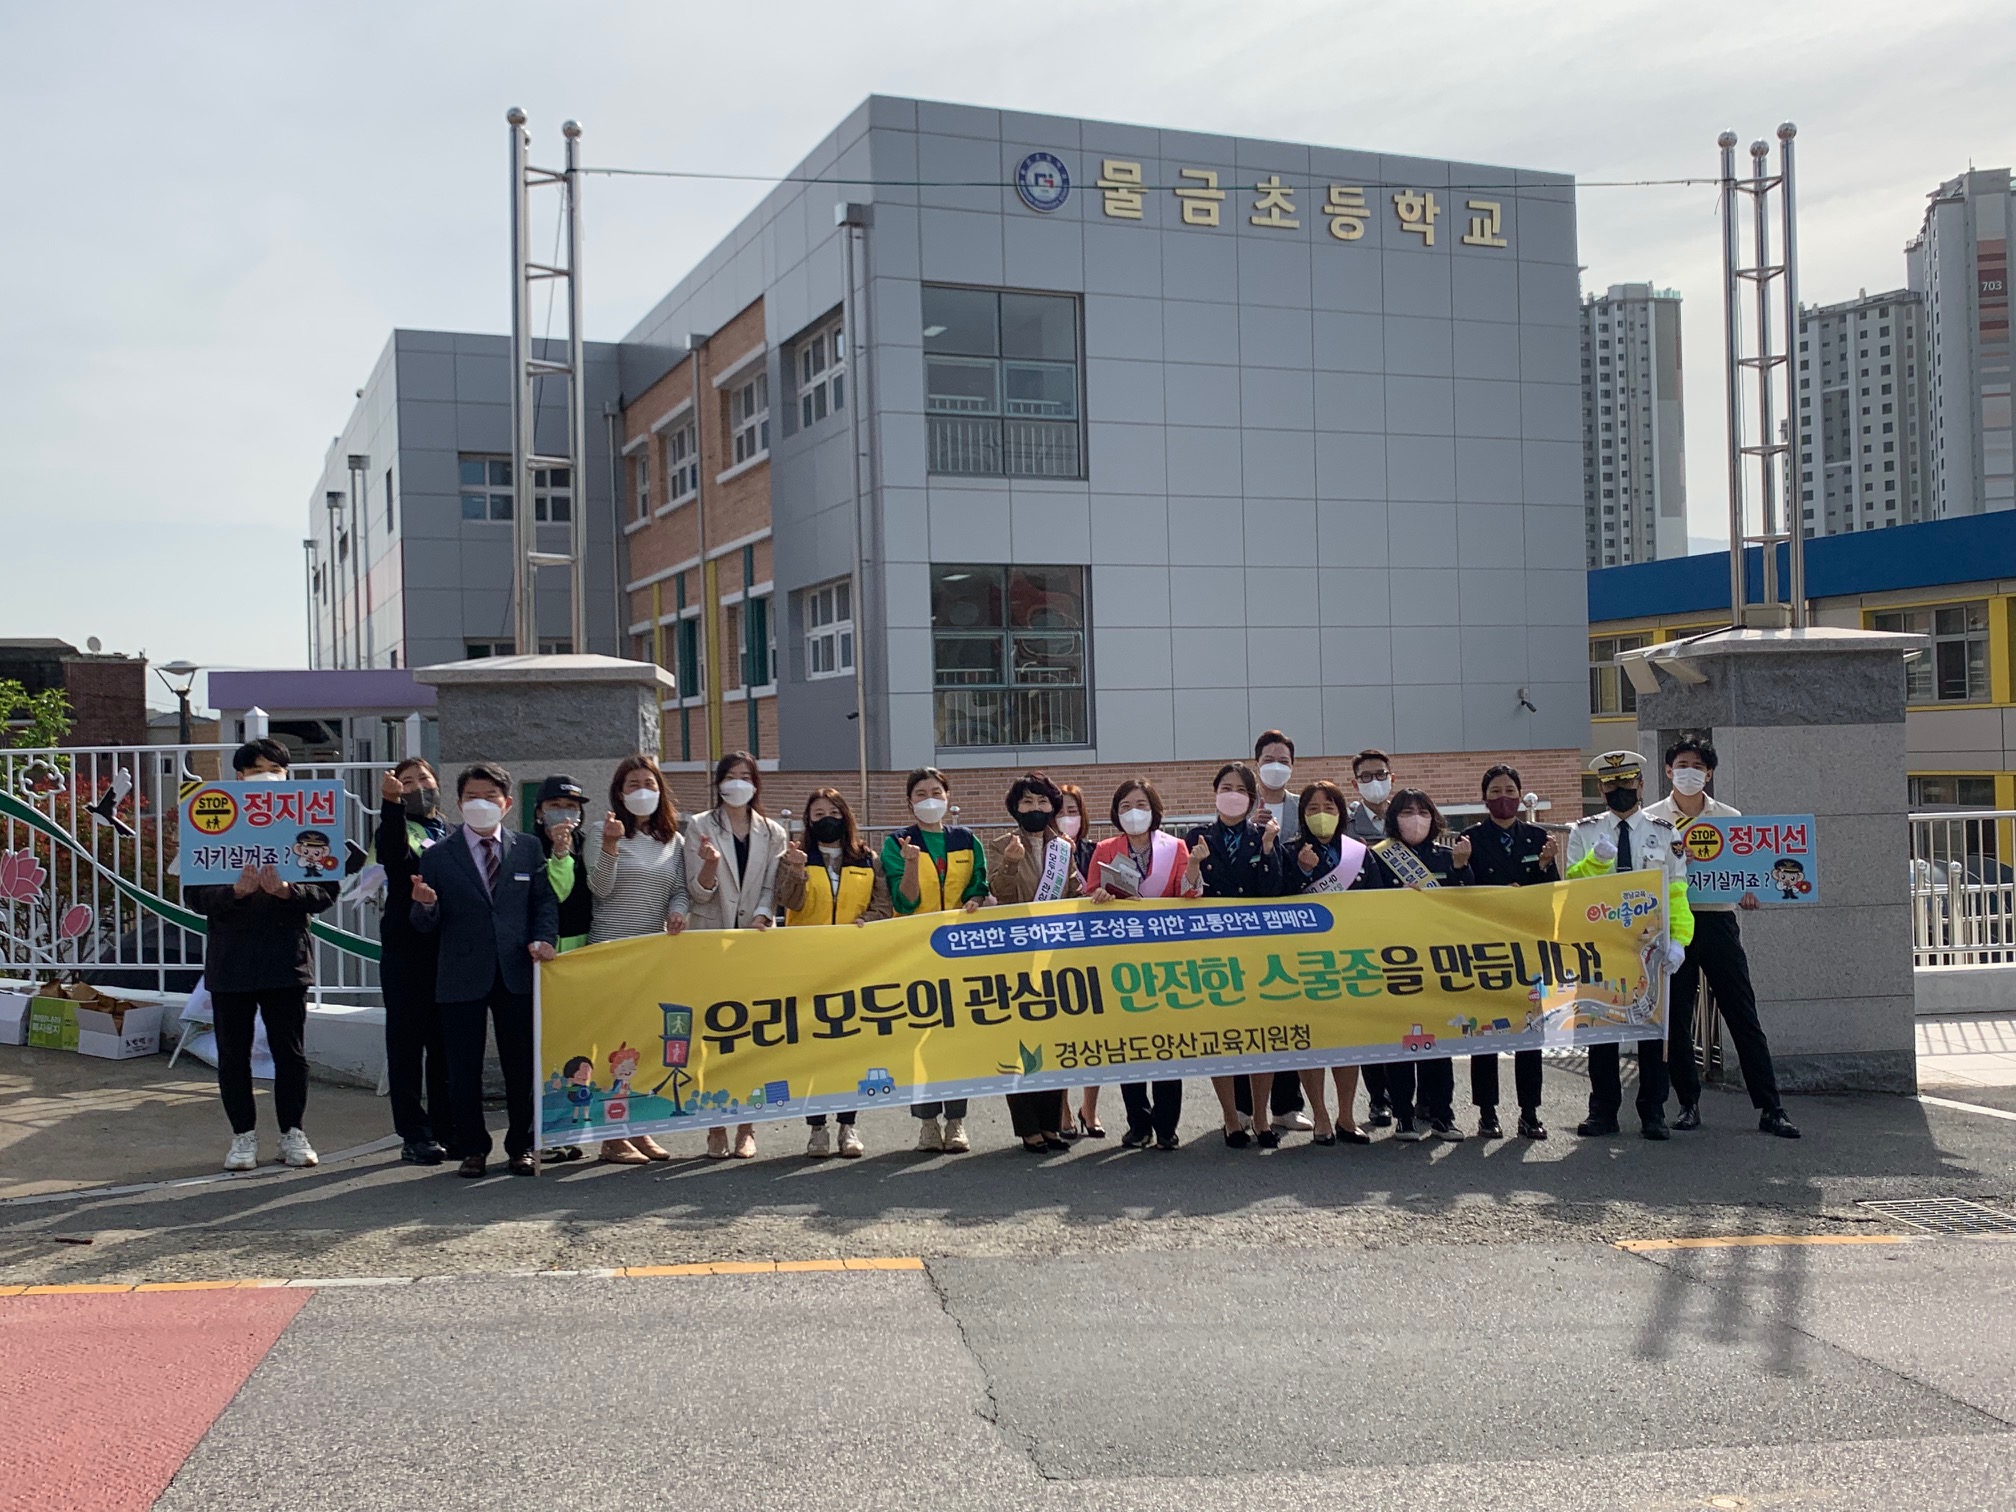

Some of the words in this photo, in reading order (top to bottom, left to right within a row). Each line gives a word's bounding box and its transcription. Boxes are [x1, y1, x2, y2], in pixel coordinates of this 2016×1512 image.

[1097, 158, 1507, 247] 물금초등학교
[1982, 280, 2003, 291] 703
[198, 797, 229, 810] STOP
[243, 790, 336, 827] 정지선
[1691, 830, 1716, 840] STOP
[1728, 825, 1807, 855] 정지선
[947, 927, 1006, 951] 안전한
[1009, 920, 1085, 945] 등하굣길
[1090, 917, 1144, 939] 조성을
[1148, 915, 1185, 936] 위한
[1189, 910, 1261, 933] 교통안전
[1263, 908, 1318, 929] 캠페인
[1586, 897, 1658, 928] 아이좋아
[702, 996, 798, 1054] 우리
[812, 979, 955, 1038] 모두의
[962, 966, 1104, 1025] 관심이
[1111, 956, 1246, 1013] 안전한
[1258, 946, 1424, 1001] 스쿨존을
[1429, 939, 1603, 992] 만듭니다!
[1054, 1024, 1311, 1069] 경상남도양산교육지원청
